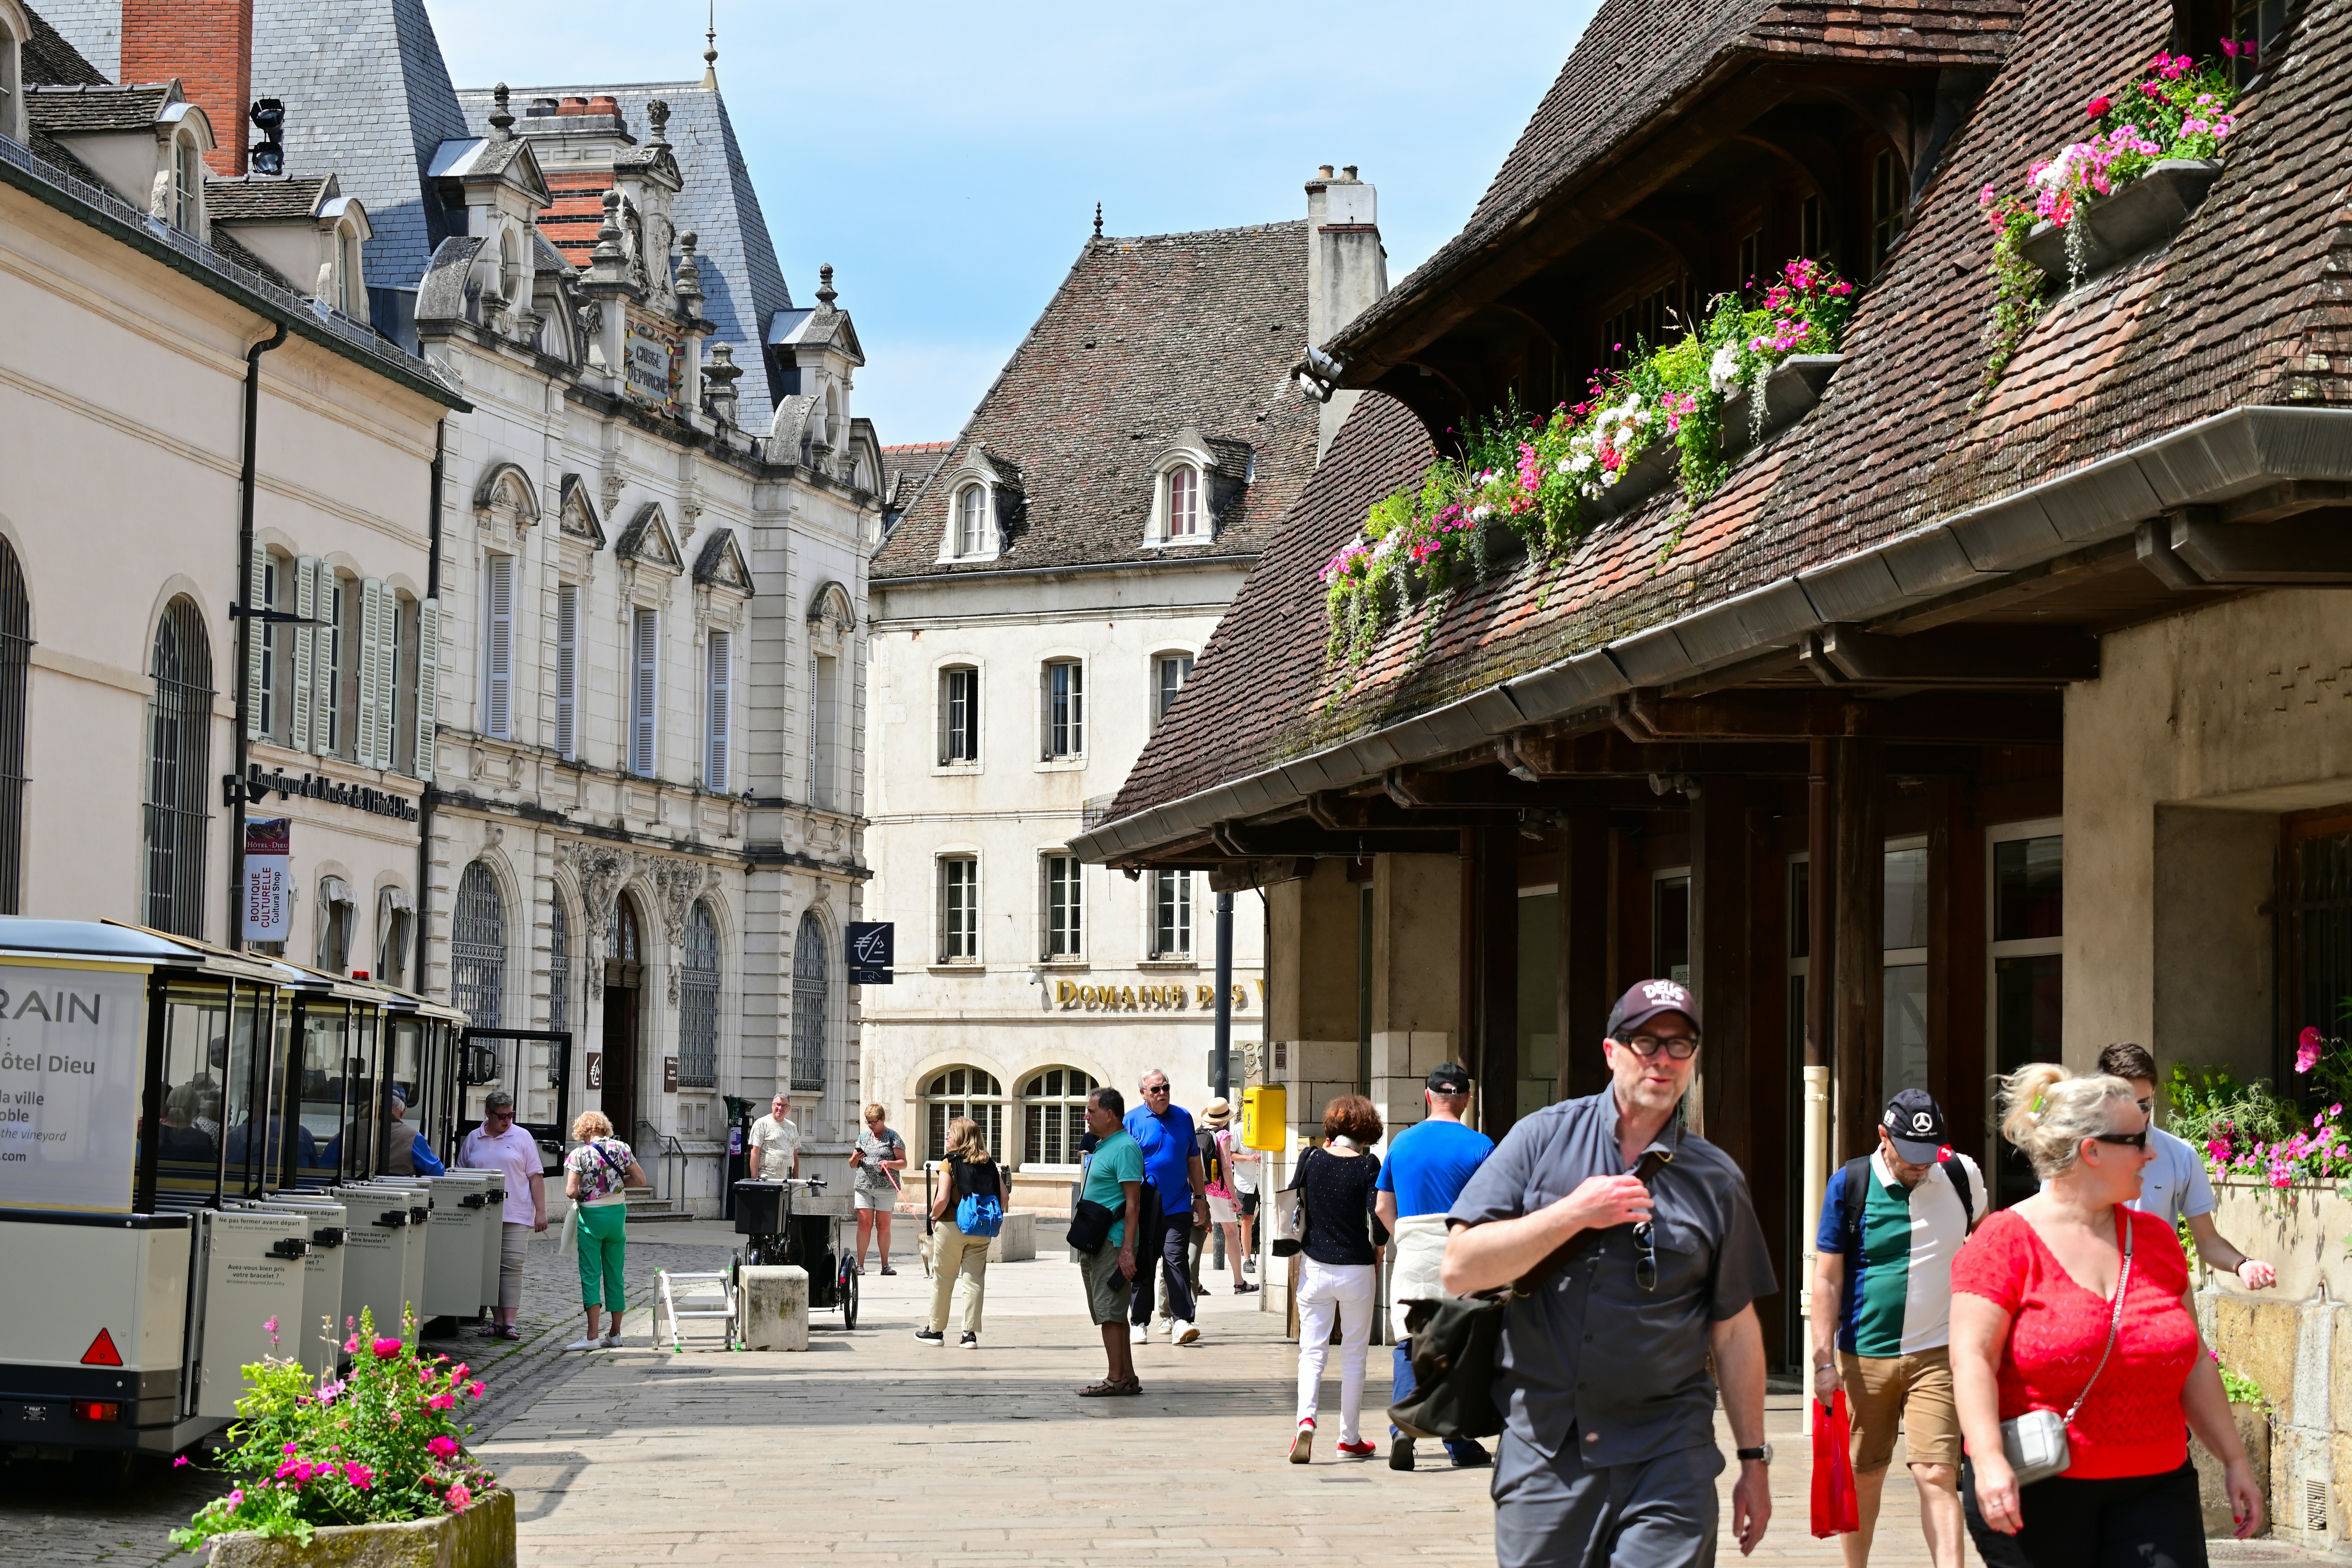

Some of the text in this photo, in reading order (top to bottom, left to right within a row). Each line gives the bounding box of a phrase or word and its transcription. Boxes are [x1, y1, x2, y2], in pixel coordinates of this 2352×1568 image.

[637, 346, 662, 369] CAISSE
[252, 763, 419, 822] Boutique du Musée de l'Hôtel-Dieu
[272, 871, 282, 891] Shop
[251, 873, 260, 921] BOUTIQUE
[261, 867, 271, 928] CULTURELLE
[1055, 980, 1183, 1004] DOMAINE
[1195, 984, 1243, 1004] DS
[1642, 981, 1684, 1000] DEUS
[1, 1052, 95, 1074] ôtel Dieu
[15, 1091, 44, 1105] ville
[1, 1127, 67, 1142] the vineyard
